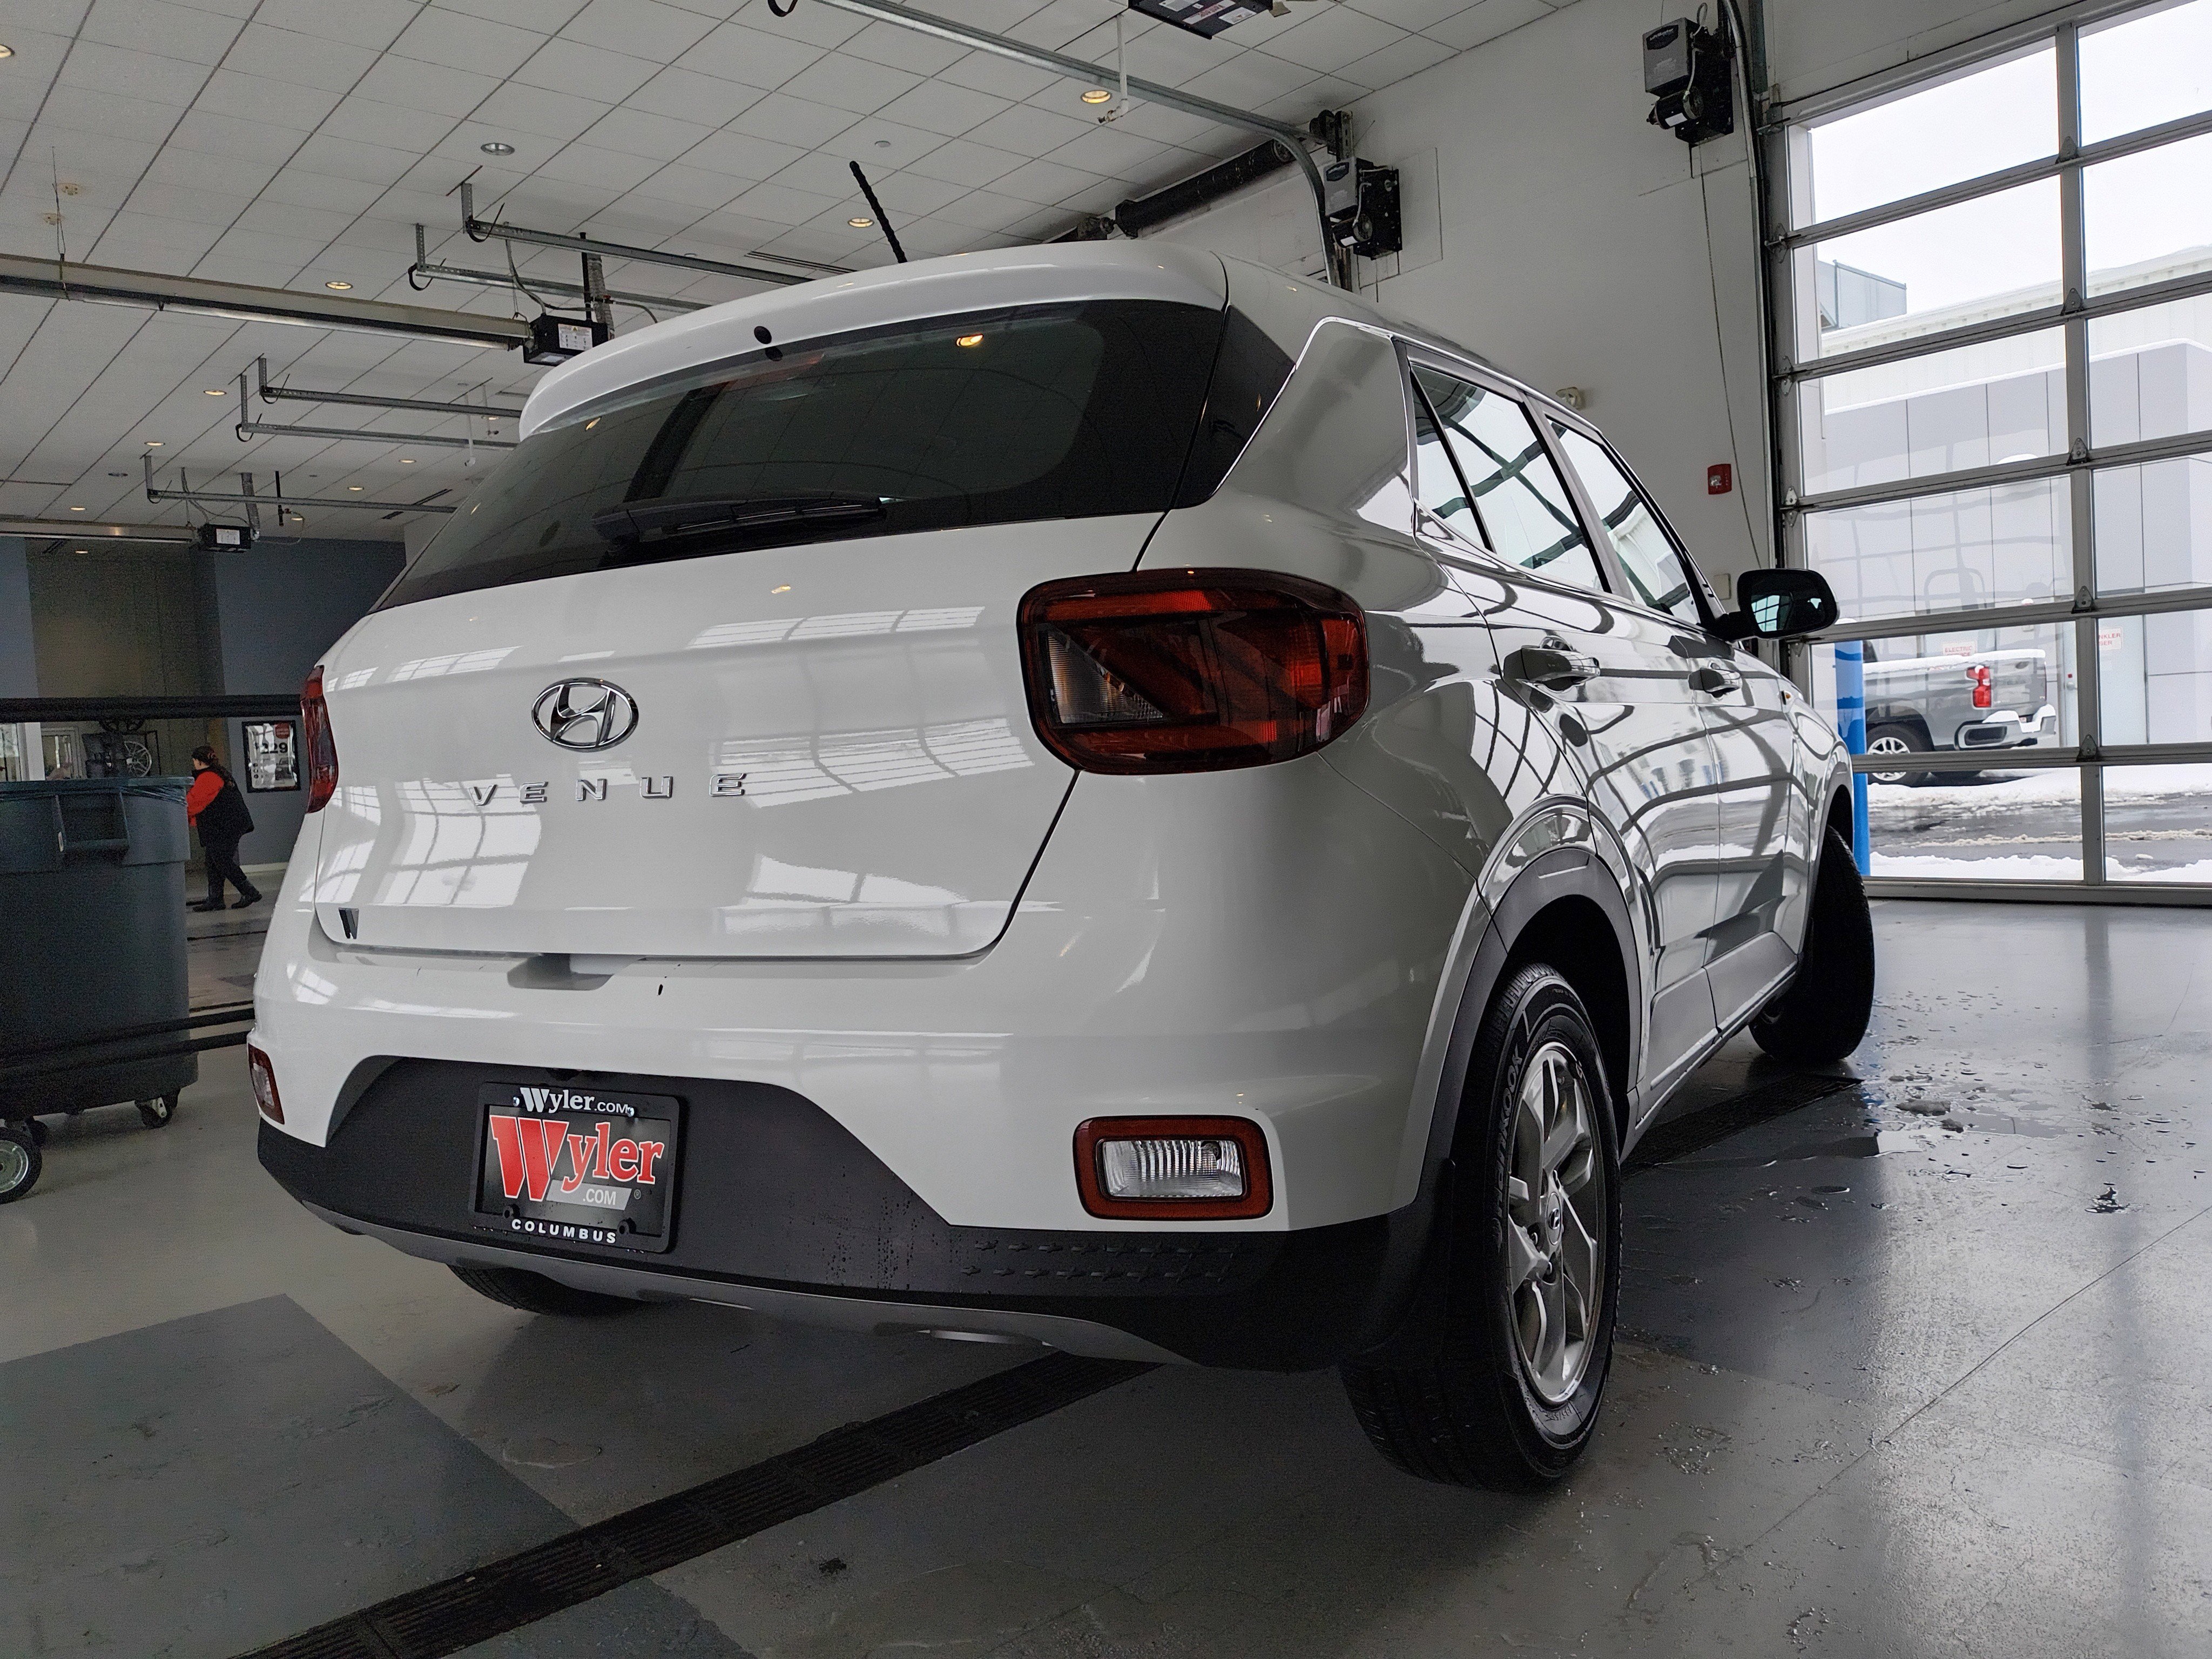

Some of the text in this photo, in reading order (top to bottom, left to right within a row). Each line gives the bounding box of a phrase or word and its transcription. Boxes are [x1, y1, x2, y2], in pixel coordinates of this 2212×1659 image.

[468, 772, 747, 806] VENUE
[489, 1115, 665, 1202] Wyler
[583, 1188, 616, 1205] .COM
[511, 1218, 616, 1244] COLUMBUS
